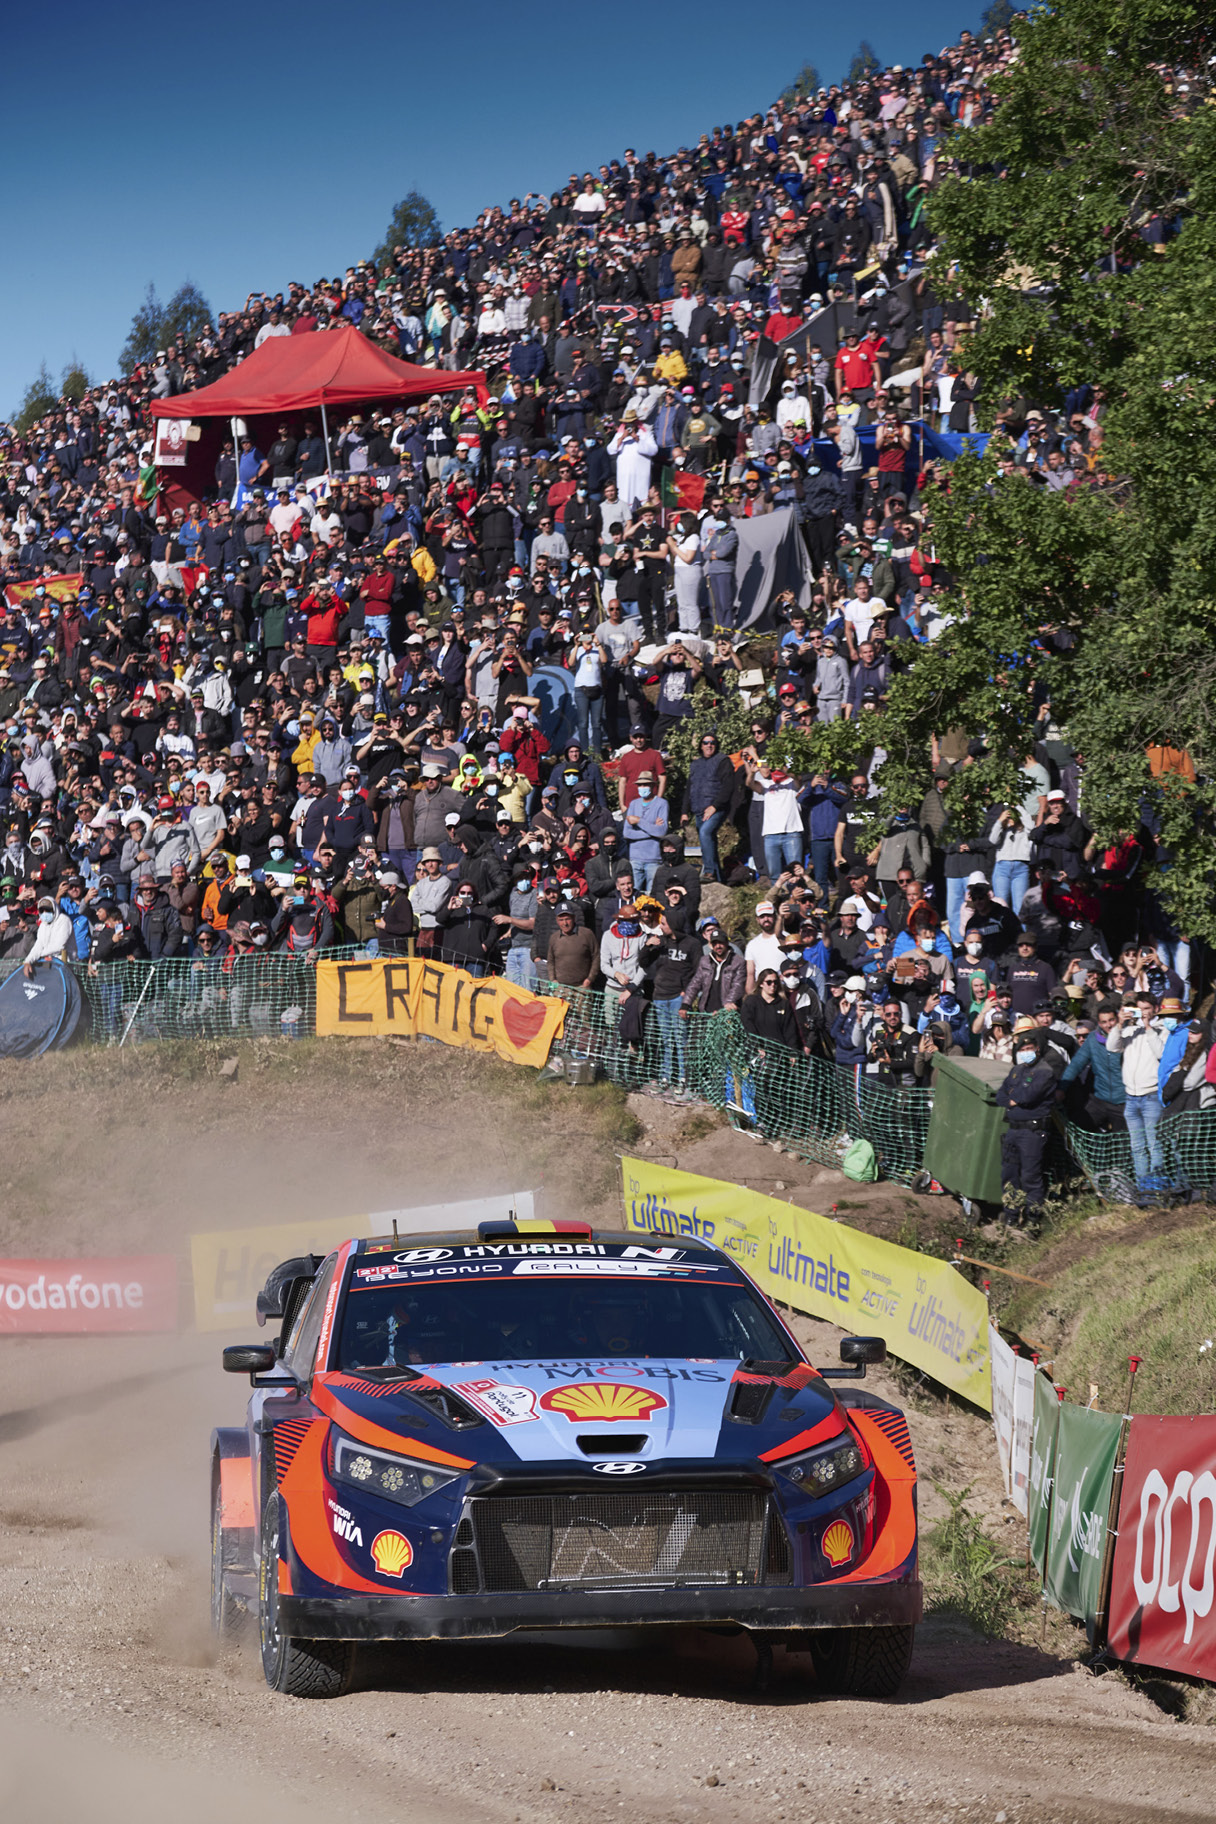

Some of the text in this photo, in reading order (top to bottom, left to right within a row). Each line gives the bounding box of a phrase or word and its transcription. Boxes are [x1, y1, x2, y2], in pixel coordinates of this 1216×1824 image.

[337, 963, 497, 1041] CRAIG
[628, 1175, 640, 1197] bp
[631, 1193, 716, 1239] ultimate
[767, 1215, 778, 1239] bp
[464, 1244, 606, 1257] HYUNDAI
[722, 1235, 759, 1259] ACTIVE
[365, 1264, 503, 1283] BEYOND
[530, 1262, 638, 1272] RALLY
[768, 1235, 850, 1303] ultimate
[915, 1272, 927, 1297] bp
[861, 1289, 899, 1318] ACTIVE
[908, 1295, 966, 1363] ultimate
[491, 1361, 639, 1372] HYUNDAI
[545, 1366, 728, 1383] MOBIS
[484, 1391, 519, 1417] Portugal
[327, 1498, 351, 1520] HYUNDAI
[333, 1513, 364, 1547] WIA
